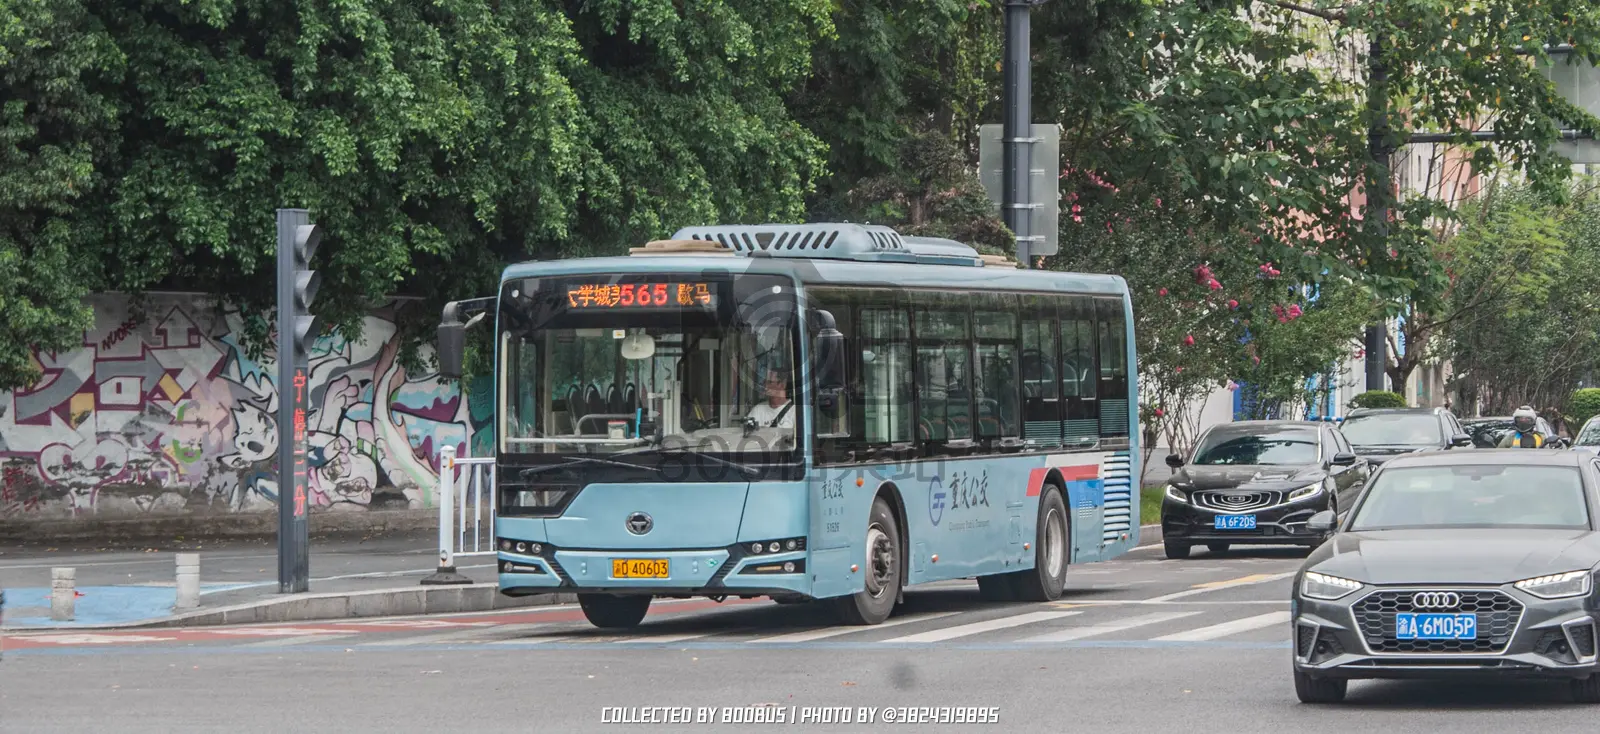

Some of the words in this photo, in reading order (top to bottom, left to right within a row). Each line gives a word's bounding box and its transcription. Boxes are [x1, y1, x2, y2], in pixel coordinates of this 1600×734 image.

[621, 284, 668, 306] 565
[677, 283, 711, 306] 歇马
[949, 469, 990, 510] 重庆公交
